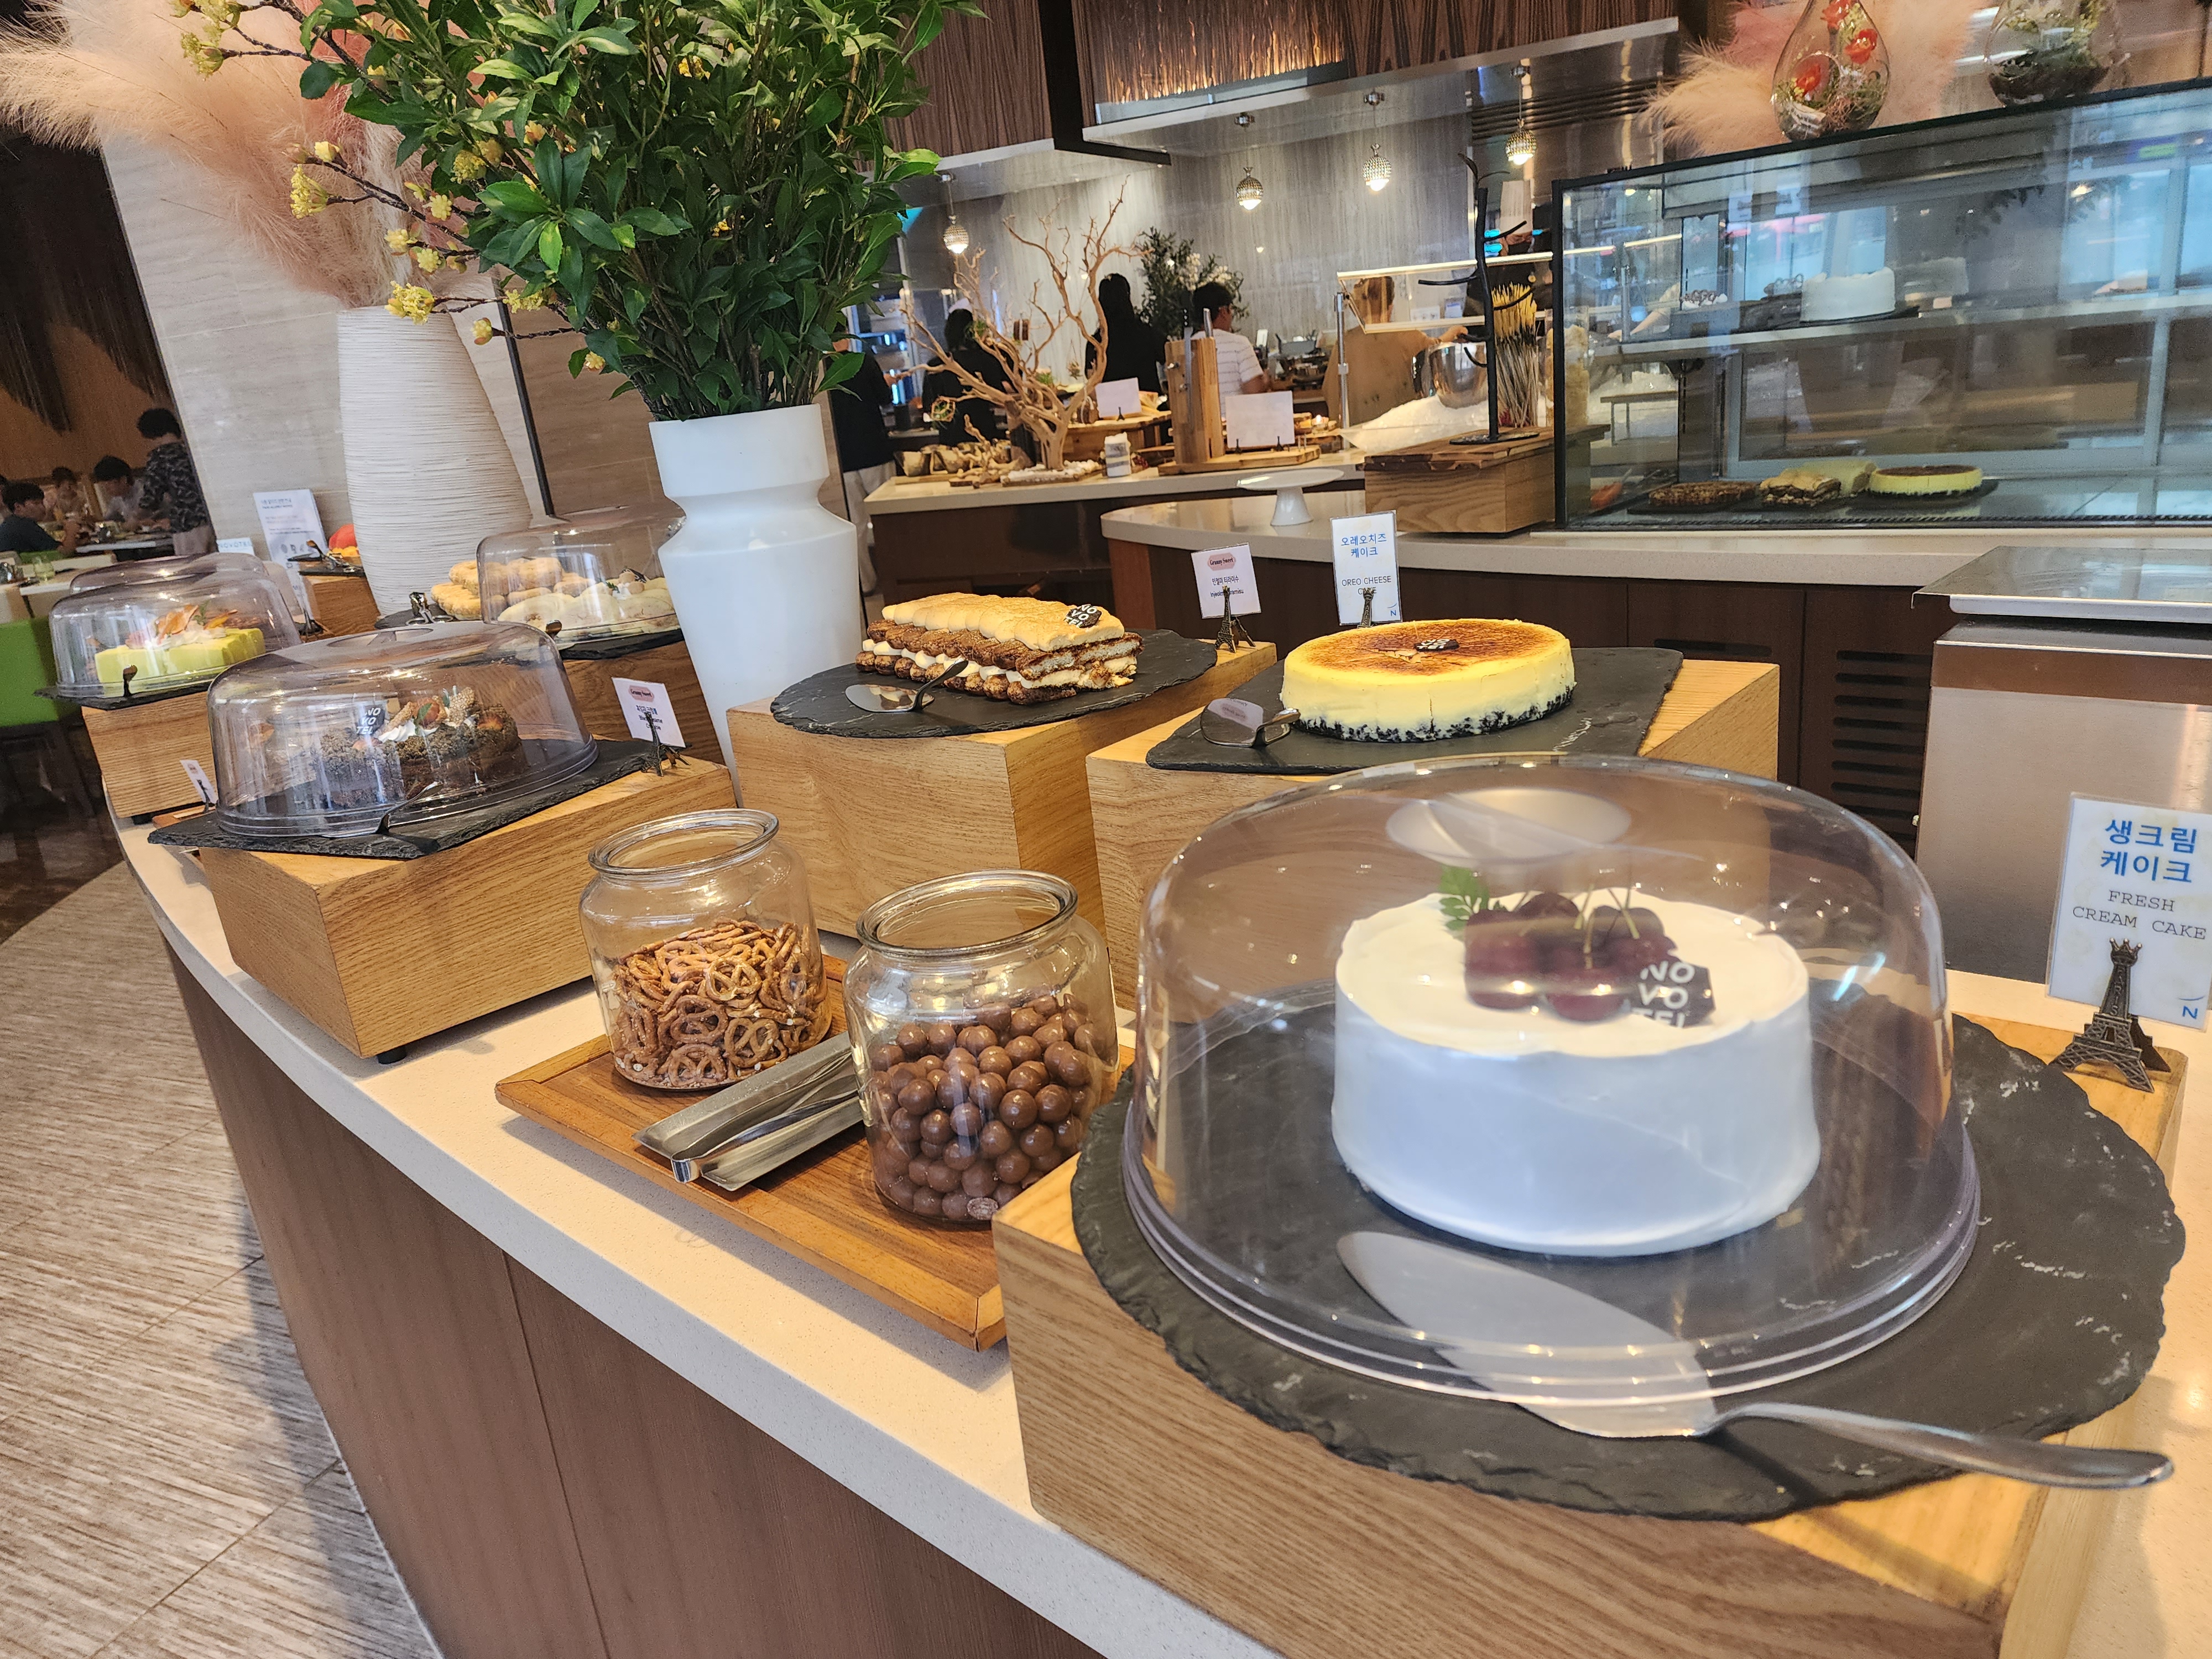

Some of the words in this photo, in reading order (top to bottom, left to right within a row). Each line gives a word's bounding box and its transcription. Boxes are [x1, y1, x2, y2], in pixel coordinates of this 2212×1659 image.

[1341, 534, 1387, 546] 오레오치즈
[1351, 547, 1378, 558] 케이크
[1224, 575, 1239, 583] 티라미수
[1342, 578, 1361, 586] OREO
[1364, 576, 1391, 585] CHEESE
[2105, 819, 2197, 854] 생크림
[2101, 850, 2192, 883] 케이크
[2107, 890, 2176, 912] FRESH
[2073, 906, 2137, 928] CREAM
[2152, 920, 2206, 940] CAKE
[1638, 982, 1688, 1010] VO
